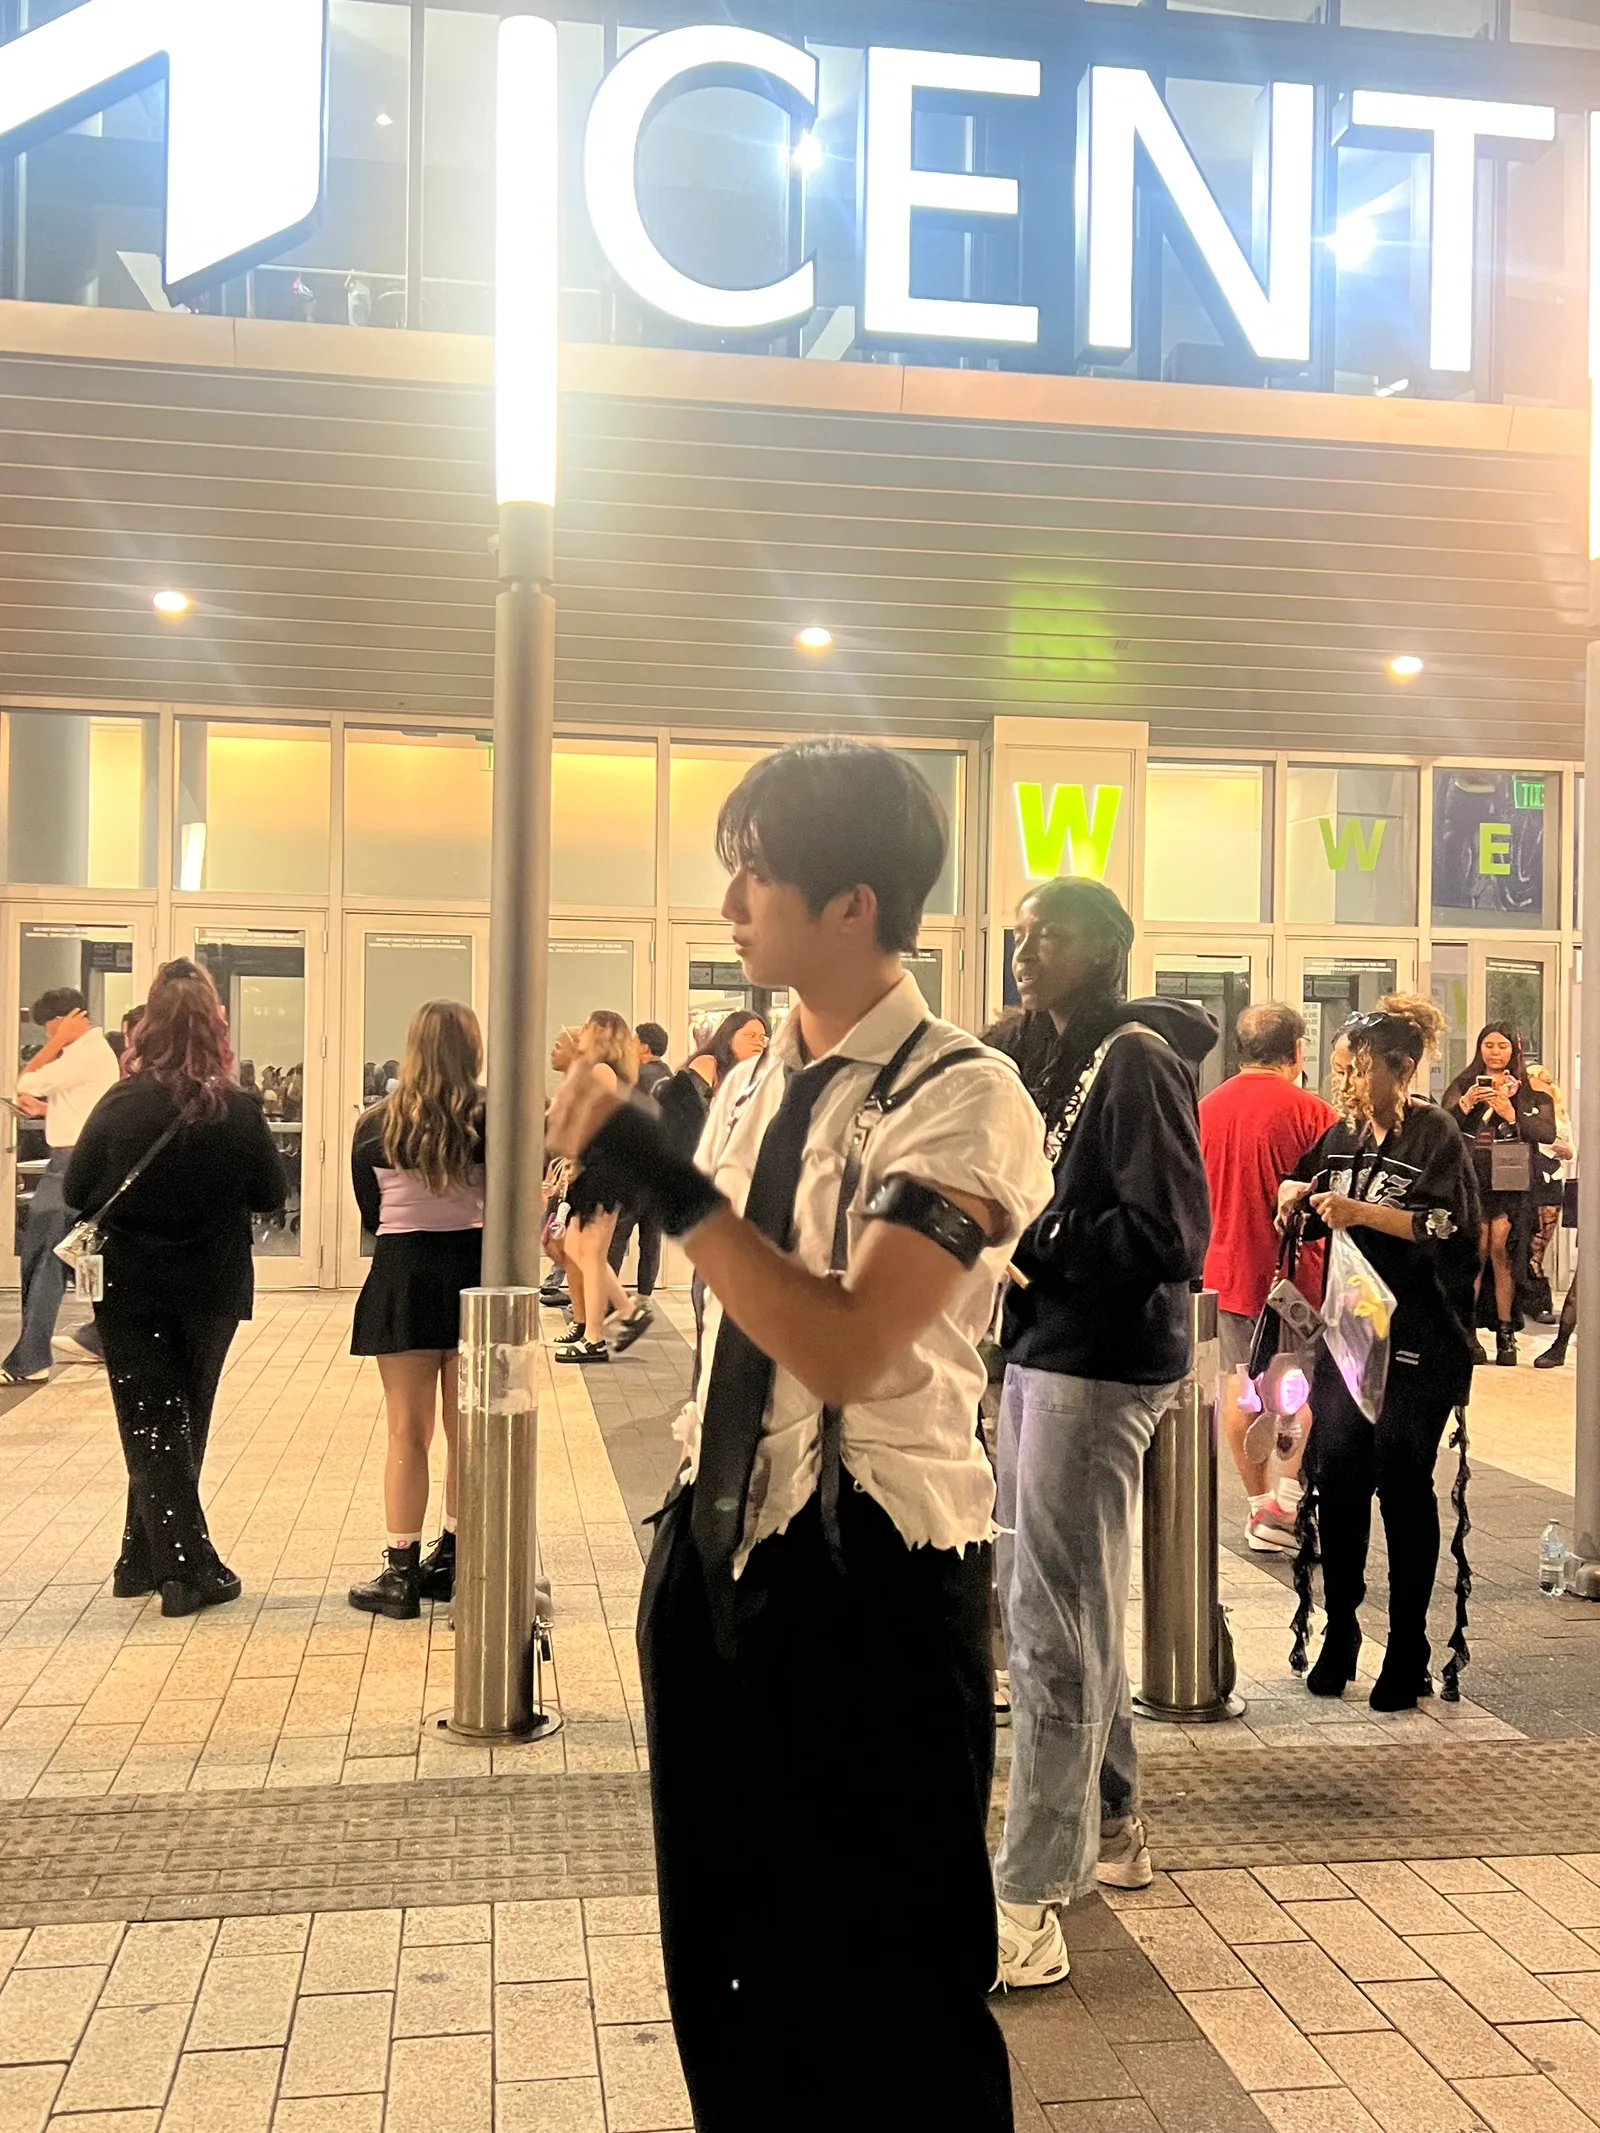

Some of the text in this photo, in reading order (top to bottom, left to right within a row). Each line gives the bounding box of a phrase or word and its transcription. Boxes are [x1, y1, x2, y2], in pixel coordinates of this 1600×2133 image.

[584, 25, 1600, 378] CENT
[1013, 782, 1123, 880] W
[1478, 822, 1512, 875] E
